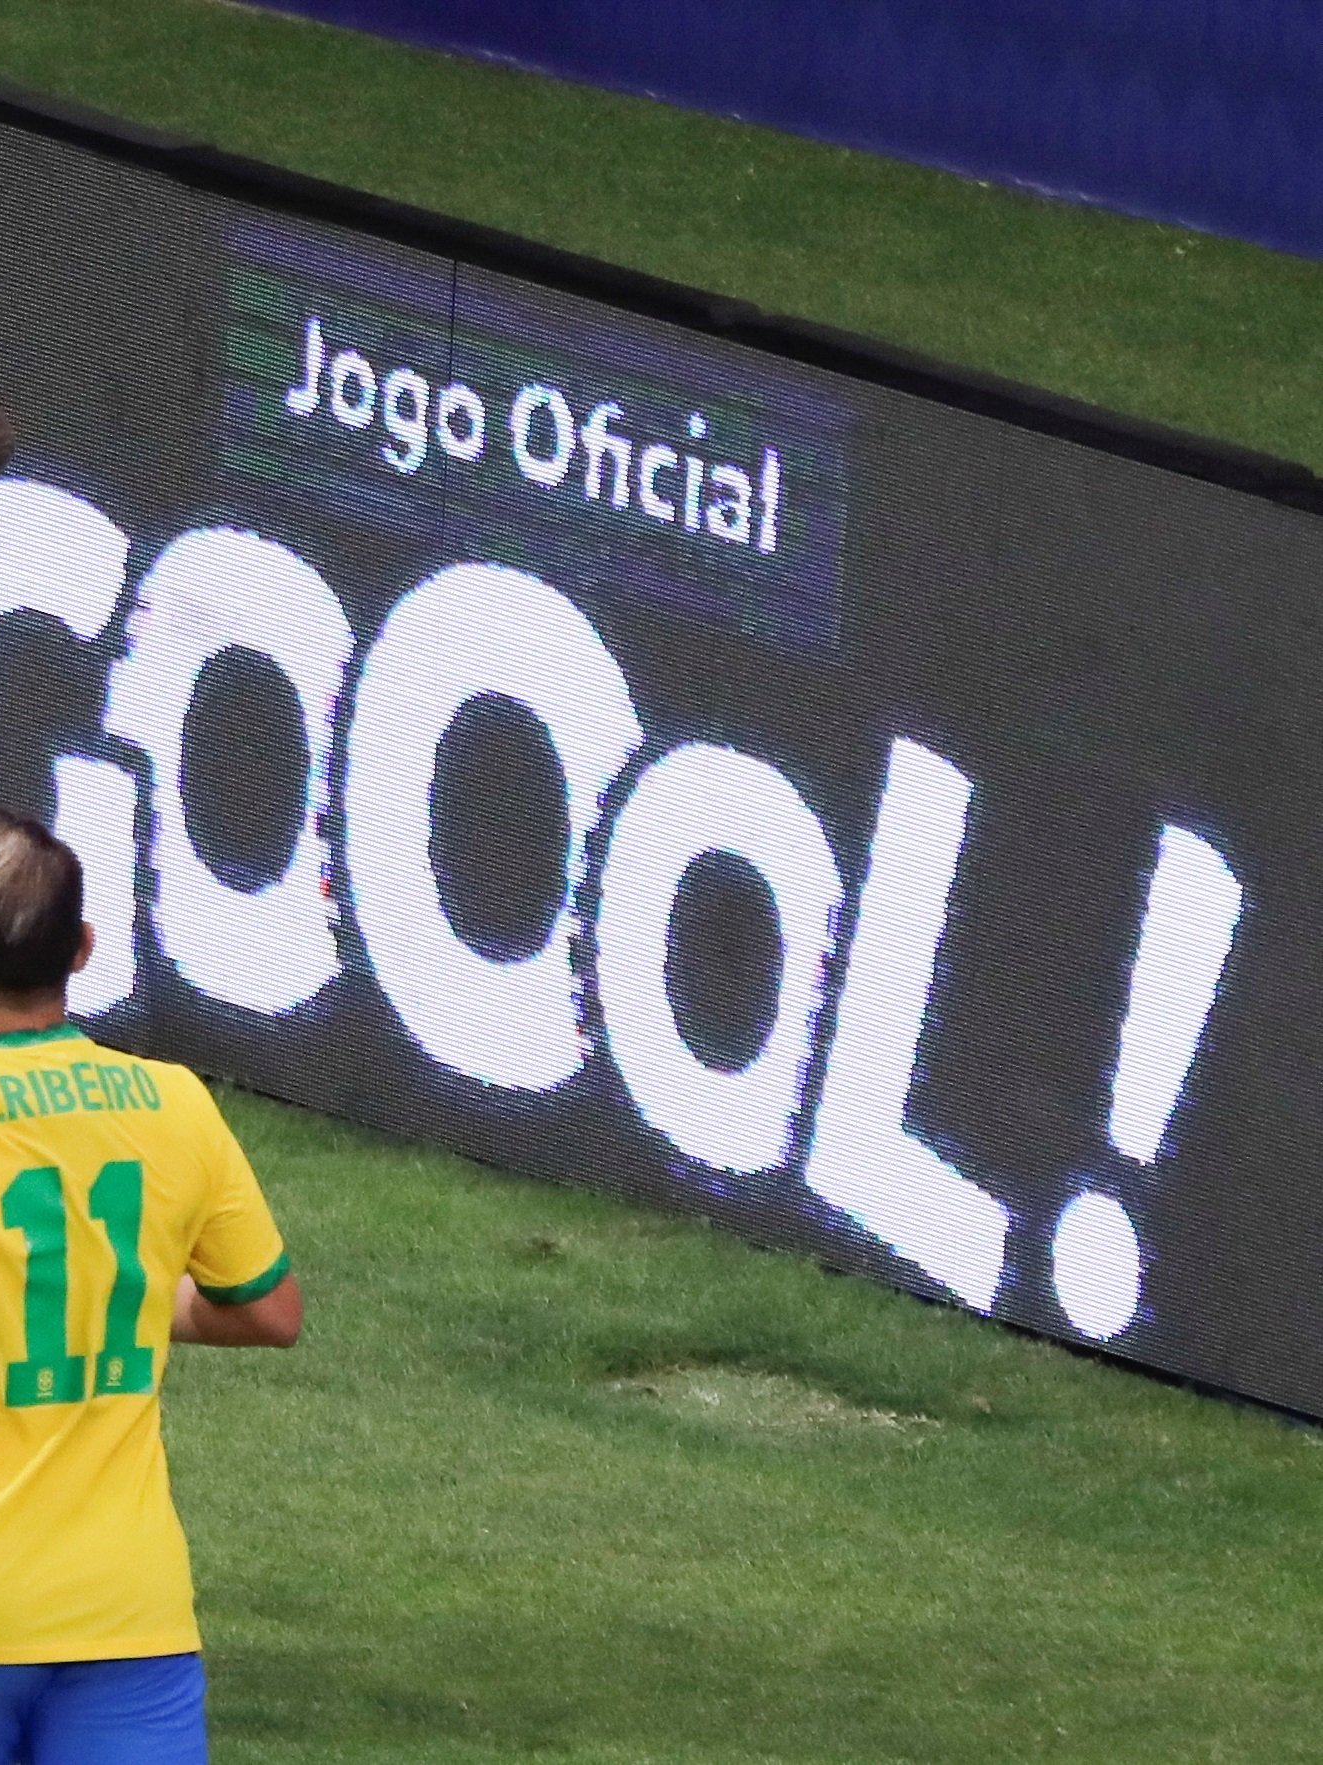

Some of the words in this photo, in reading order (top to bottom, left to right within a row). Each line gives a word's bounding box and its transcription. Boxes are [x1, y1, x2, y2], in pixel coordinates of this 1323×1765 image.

[285, 314, 486, 474] Jogo
[510, 382, 781, 553] Oficial
[1, 1160, 155, 1408] 11
